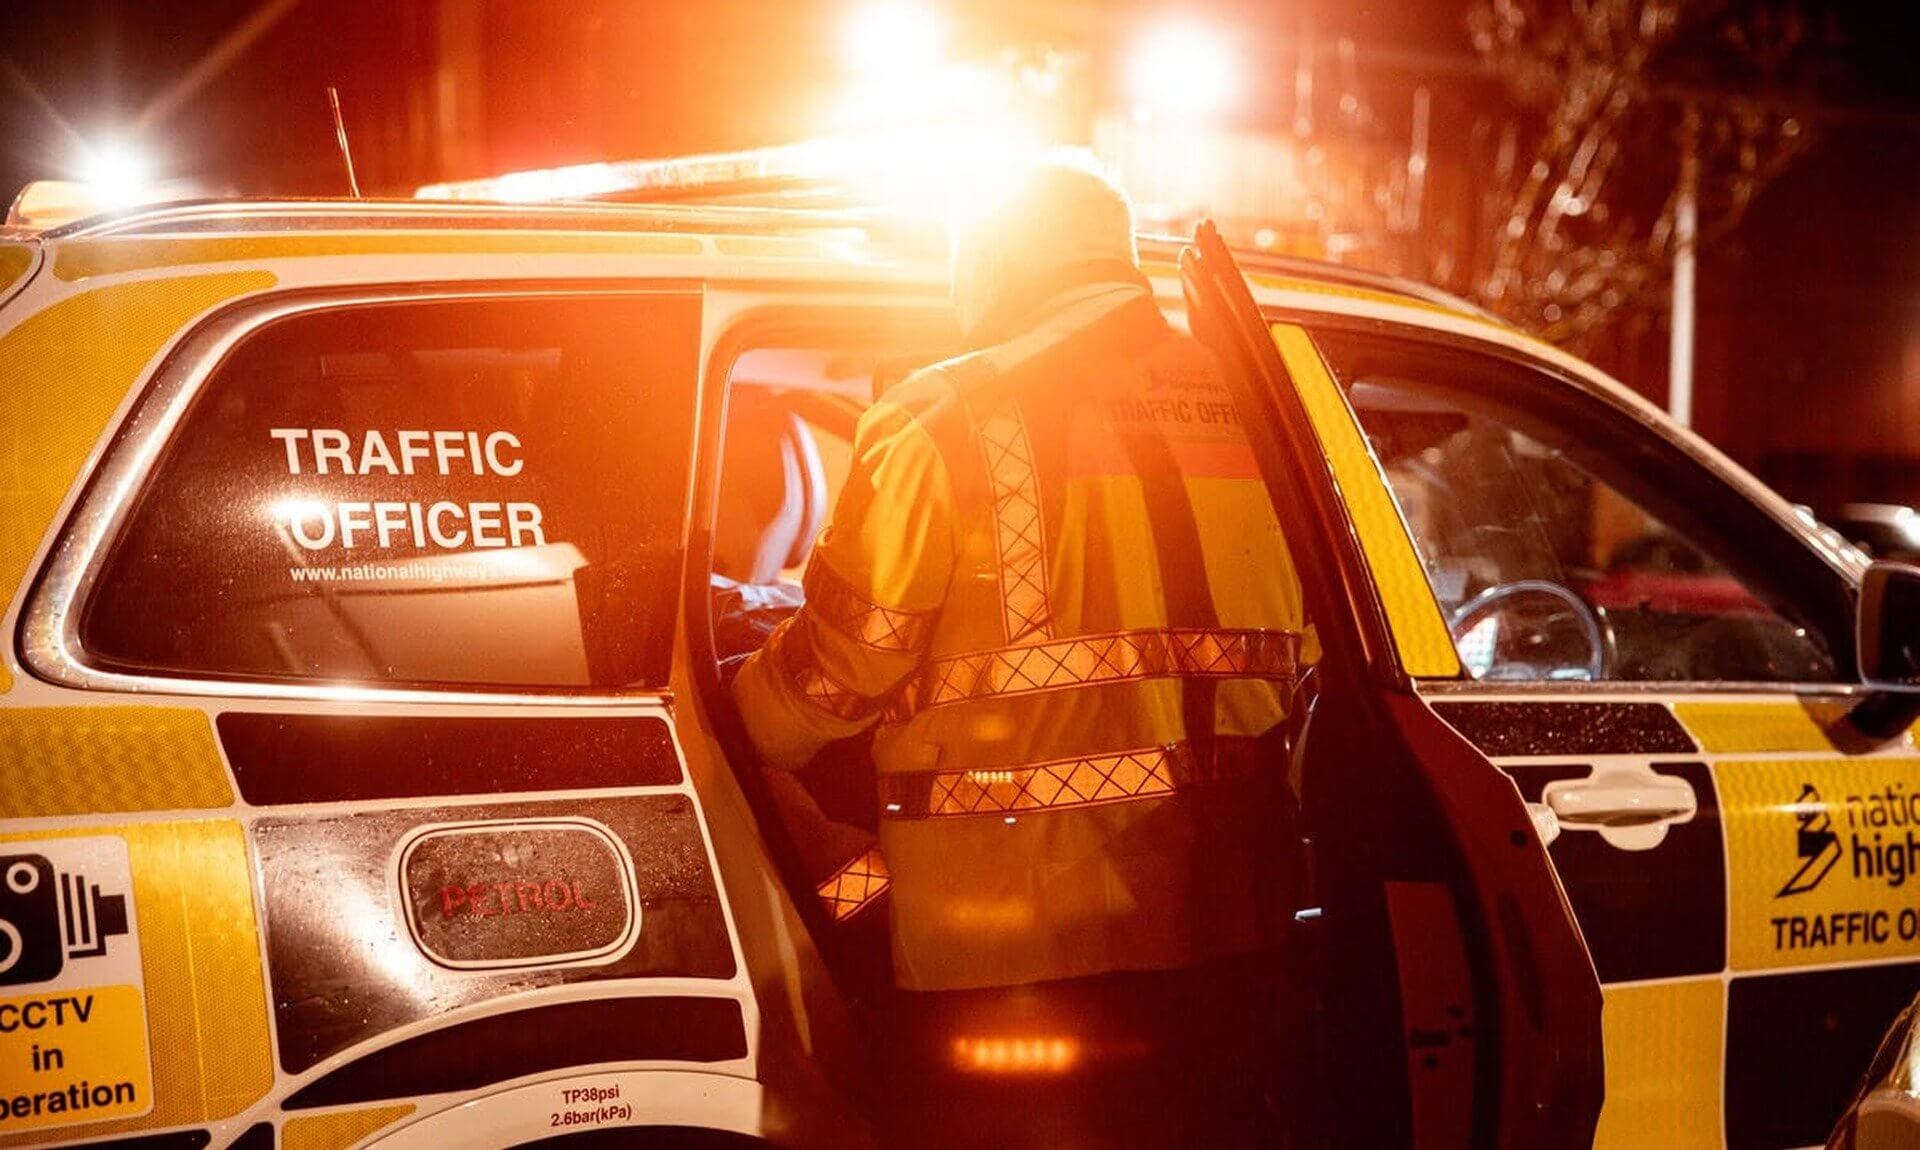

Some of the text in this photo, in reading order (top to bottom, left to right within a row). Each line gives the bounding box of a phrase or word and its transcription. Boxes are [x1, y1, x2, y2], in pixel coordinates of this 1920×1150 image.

[270, 428, 525, 477] TRAFFIC
[290, 501, 546, 551] OFFICER
[440, 878, 597, 917] PETROL
[1771, 910, 1890, 950] TRAFFIC
[0, 995, 94, 1033] CCTV
[32, 1044, 64, 1072] in
[562, 1084, 620, 1105] TP38psi
[551, 1103, 632, 1127] 2.6bar(kPa)
